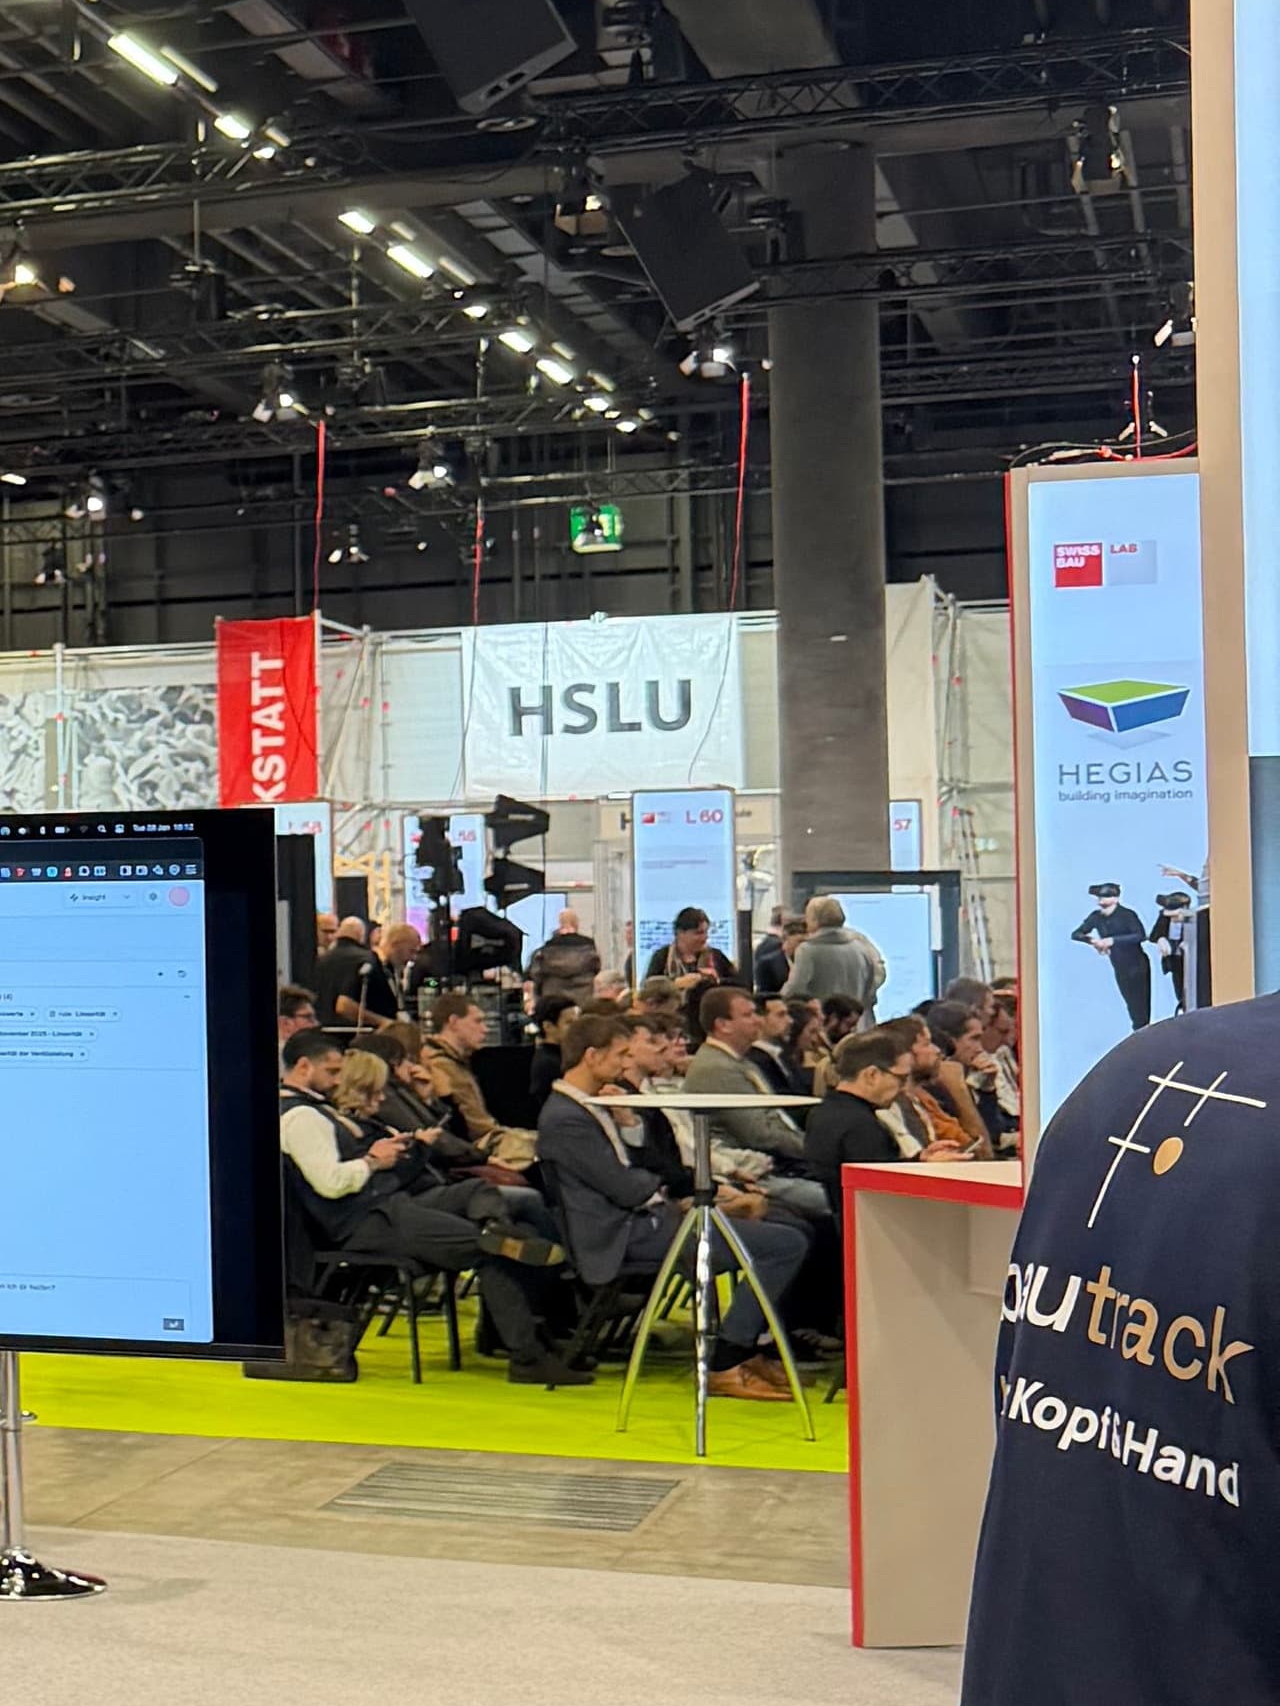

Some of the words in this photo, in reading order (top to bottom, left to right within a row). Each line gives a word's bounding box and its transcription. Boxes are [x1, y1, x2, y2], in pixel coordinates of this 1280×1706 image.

[1056, 545, 1101, 557] SWISS
[1110, 543, 1137, 554] LAB
[1056, 557, 1085, 569] BAU
[509, 678, 694, 736] HSLU
[1058, 761, 1193, 785] HEGIAS
[1058, 789, 1111, 803] building
[1114, 788, 1193, 804] imagination
[699, 809, 724, 824] 60
[893, 819, 912, 831] 57
